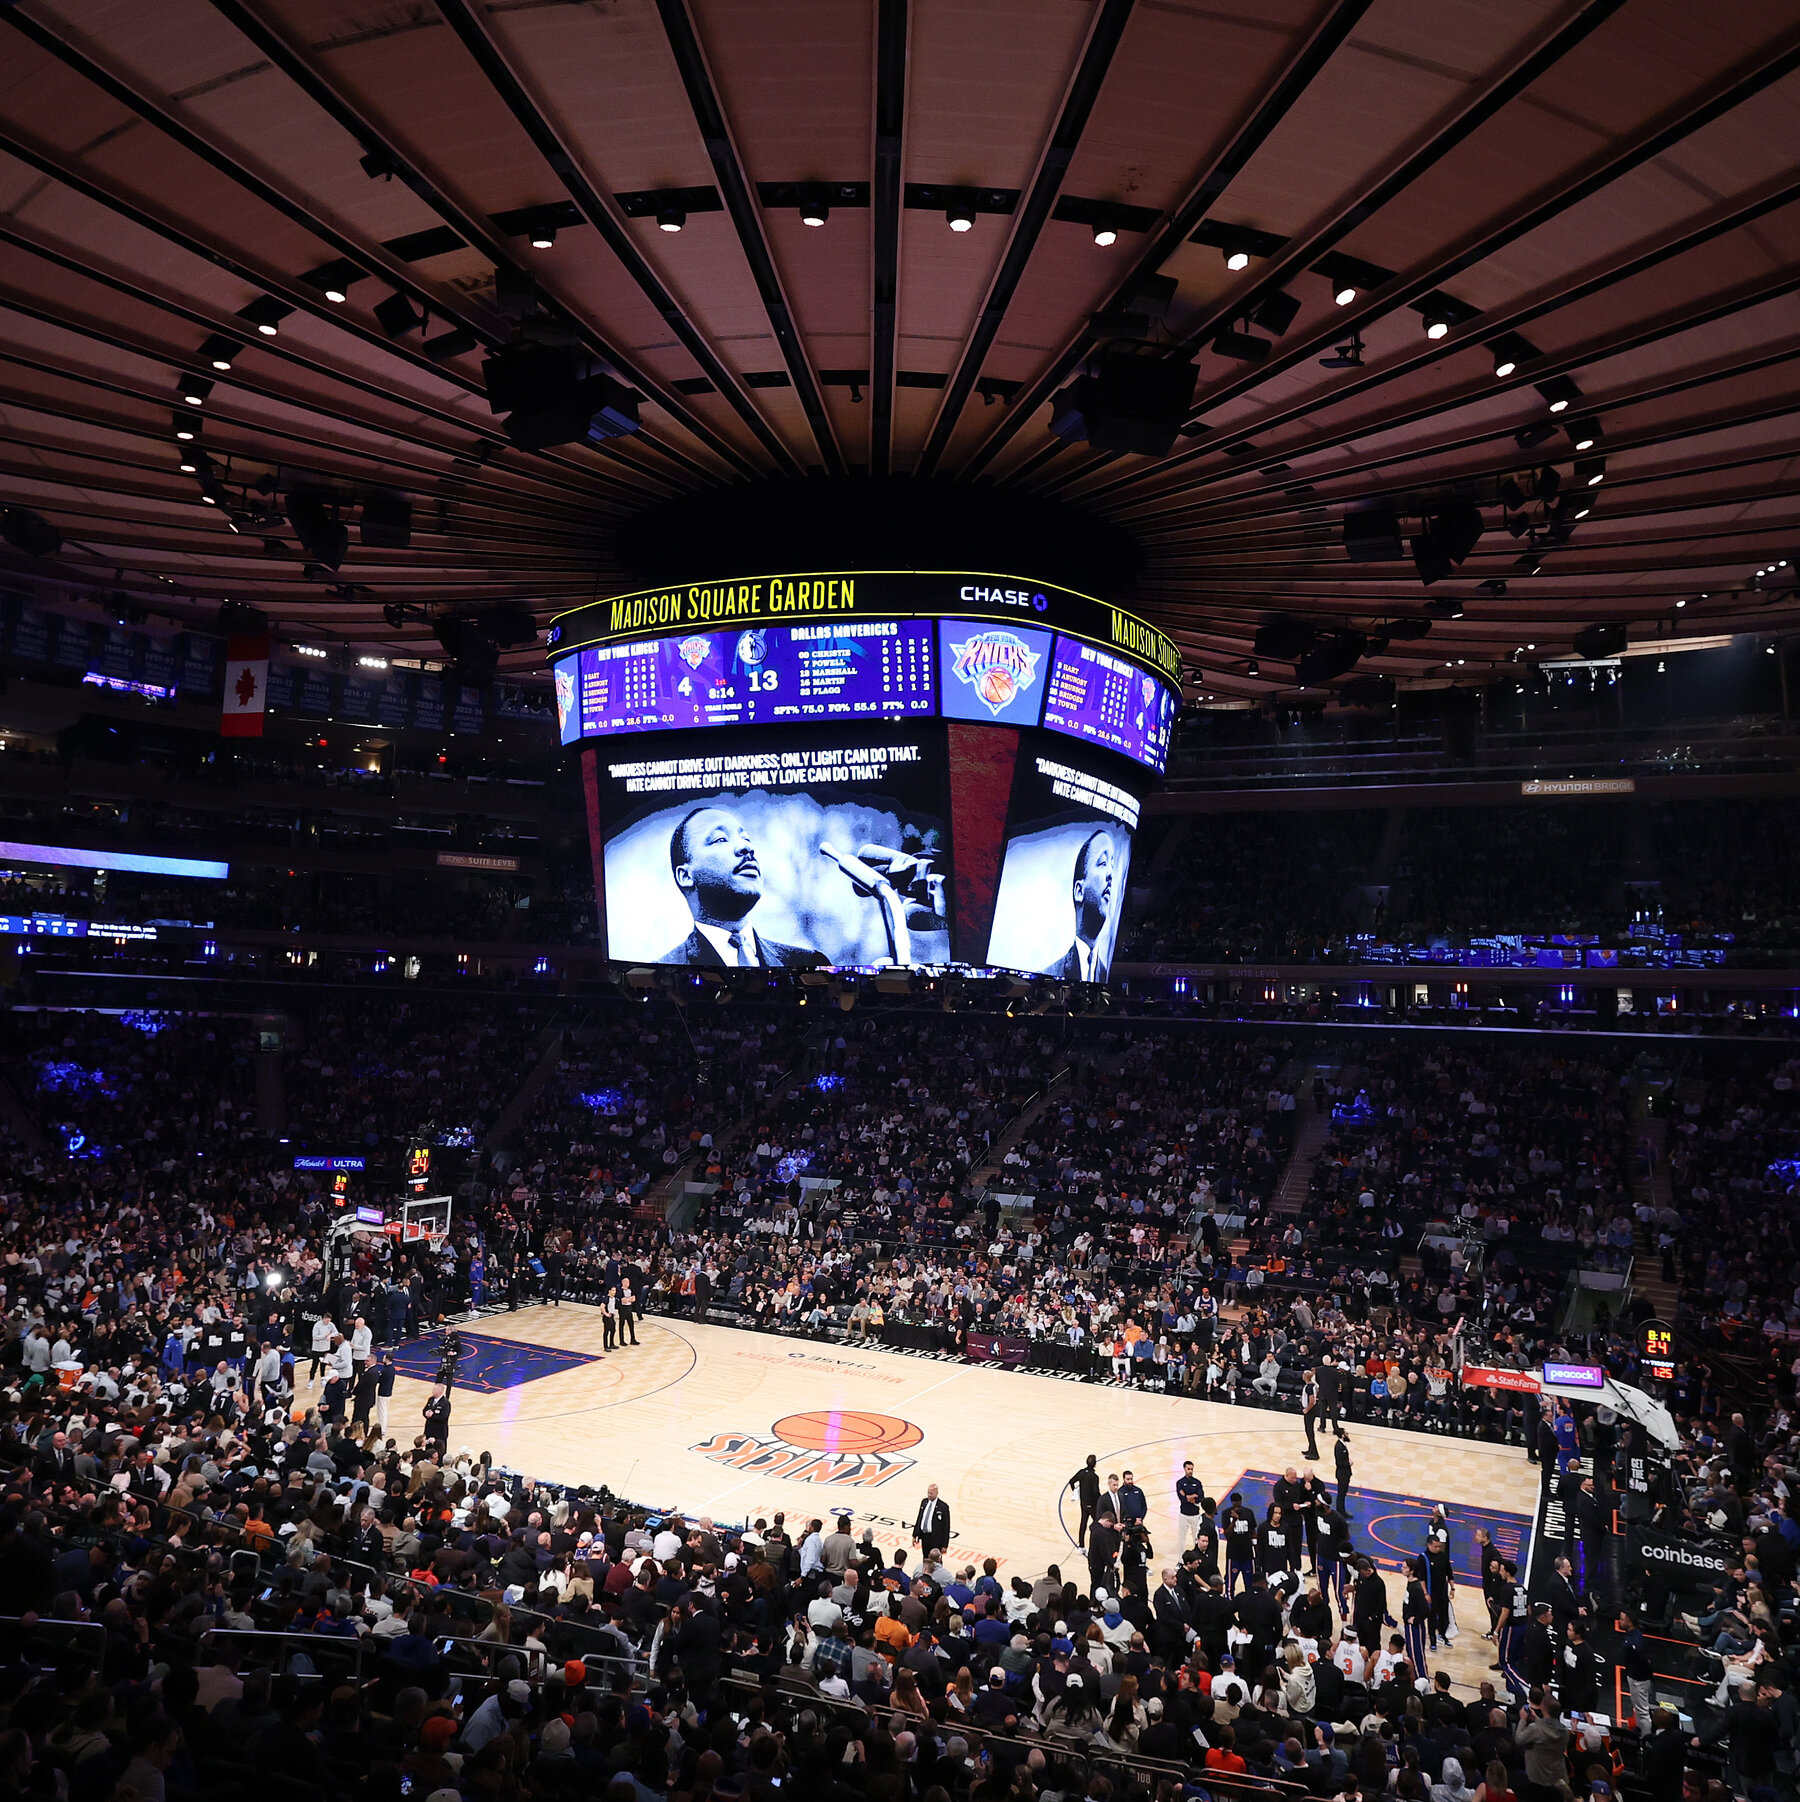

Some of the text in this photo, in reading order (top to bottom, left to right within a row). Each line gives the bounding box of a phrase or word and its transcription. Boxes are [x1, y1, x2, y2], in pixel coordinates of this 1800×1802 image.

[960, 586, 1030, 607] CHASE
[610, 579, 855, 631] MADISON SQUARE GARDEN
[790, 623, 898, 641] DALLAS MAVERICKS
[1111, 609, 1157, 660] MADISON
[598, 648, 612, 661] NEW
[630, 641, 660, 656] KNICKS
[812, 649, 851, 658] CHRISTIE
[882, 647, 889, 655] 0
[958, 641, 1032, 674] KNICKS
[1081, 646, 1096, 662] NEW
[812, 659, 846, 667] POWELL
[910, 655, 915, 663] 1
[922, 655, 929, 663] 0
[812, 667, 858, 677] MARSHALL
[910, 664, 916, 672] 1
[1063, 664, 1080, 674] HART
[677, 676, 692, 697] 4
[749, 670, 778, 692] 13
[812, 677, 845, 686] MARTIN
[896, 674, 903, 682] 0
[708, 687, 735, 699] 8:14
[812, 686, 841, 695] FLAGG
[883, 684, 890, 692] 0
[911, 683, 916, 691] 1
[748, 700, 755, 708] 0
[773, 700, 928, 715] 3PT% 75.0 FG% 55.6 FT% 0.0
[598, 720, 608, 728] 0.0
[662, 714, 674, 722] 0.0
[748, 712, 755, 720] 7
[1136, 711, 1144, 730] 4
[608, 745, 922, 778] “DARKNESS CANNOT DRIVE OUT DARKNESS; ONLY LIGHT CAN DO THAT.
[626, 762, 888, 792] HATE CANNOT DRIVE OUT HATE; ONLY LOVE CAN DO THAT.”
[1052, 779, 1071, 798] HATE
[1543, 782, 1633, 792] HYUNDAI BRIDGE
[468, 857, 491, 865] SUITE
[493, 859, 517, 867] LEVEL
[1255, 969, 1280, 978] LEVEL
[333, 1159, 363, 1167] ULTRA
[411, 1157, 427, 1175] 24
[333, 1182, 345, 1191] 24
[1646, 1341, 1668, 1355] 24
[807, 1356, 877, 1370] CHASE
[970, 1360, 1003, 1369] OF
[1013, 1364, 1087, 1382] MECCA
[1550, 1369, 1594, 1382] peacock
[688, 1432, 917, 1488] KNICKS
[1630, 1457, 1644, 1469] GET
[1632, 1468, 1645, 1480] THE
[857, 1512, 960, 1539] CASE
[1641, 1544, 1727, 1571] coinbase
[1342, 1658, 1353, 1675] 3
[1136, 1771, 1151, 1784] 108
